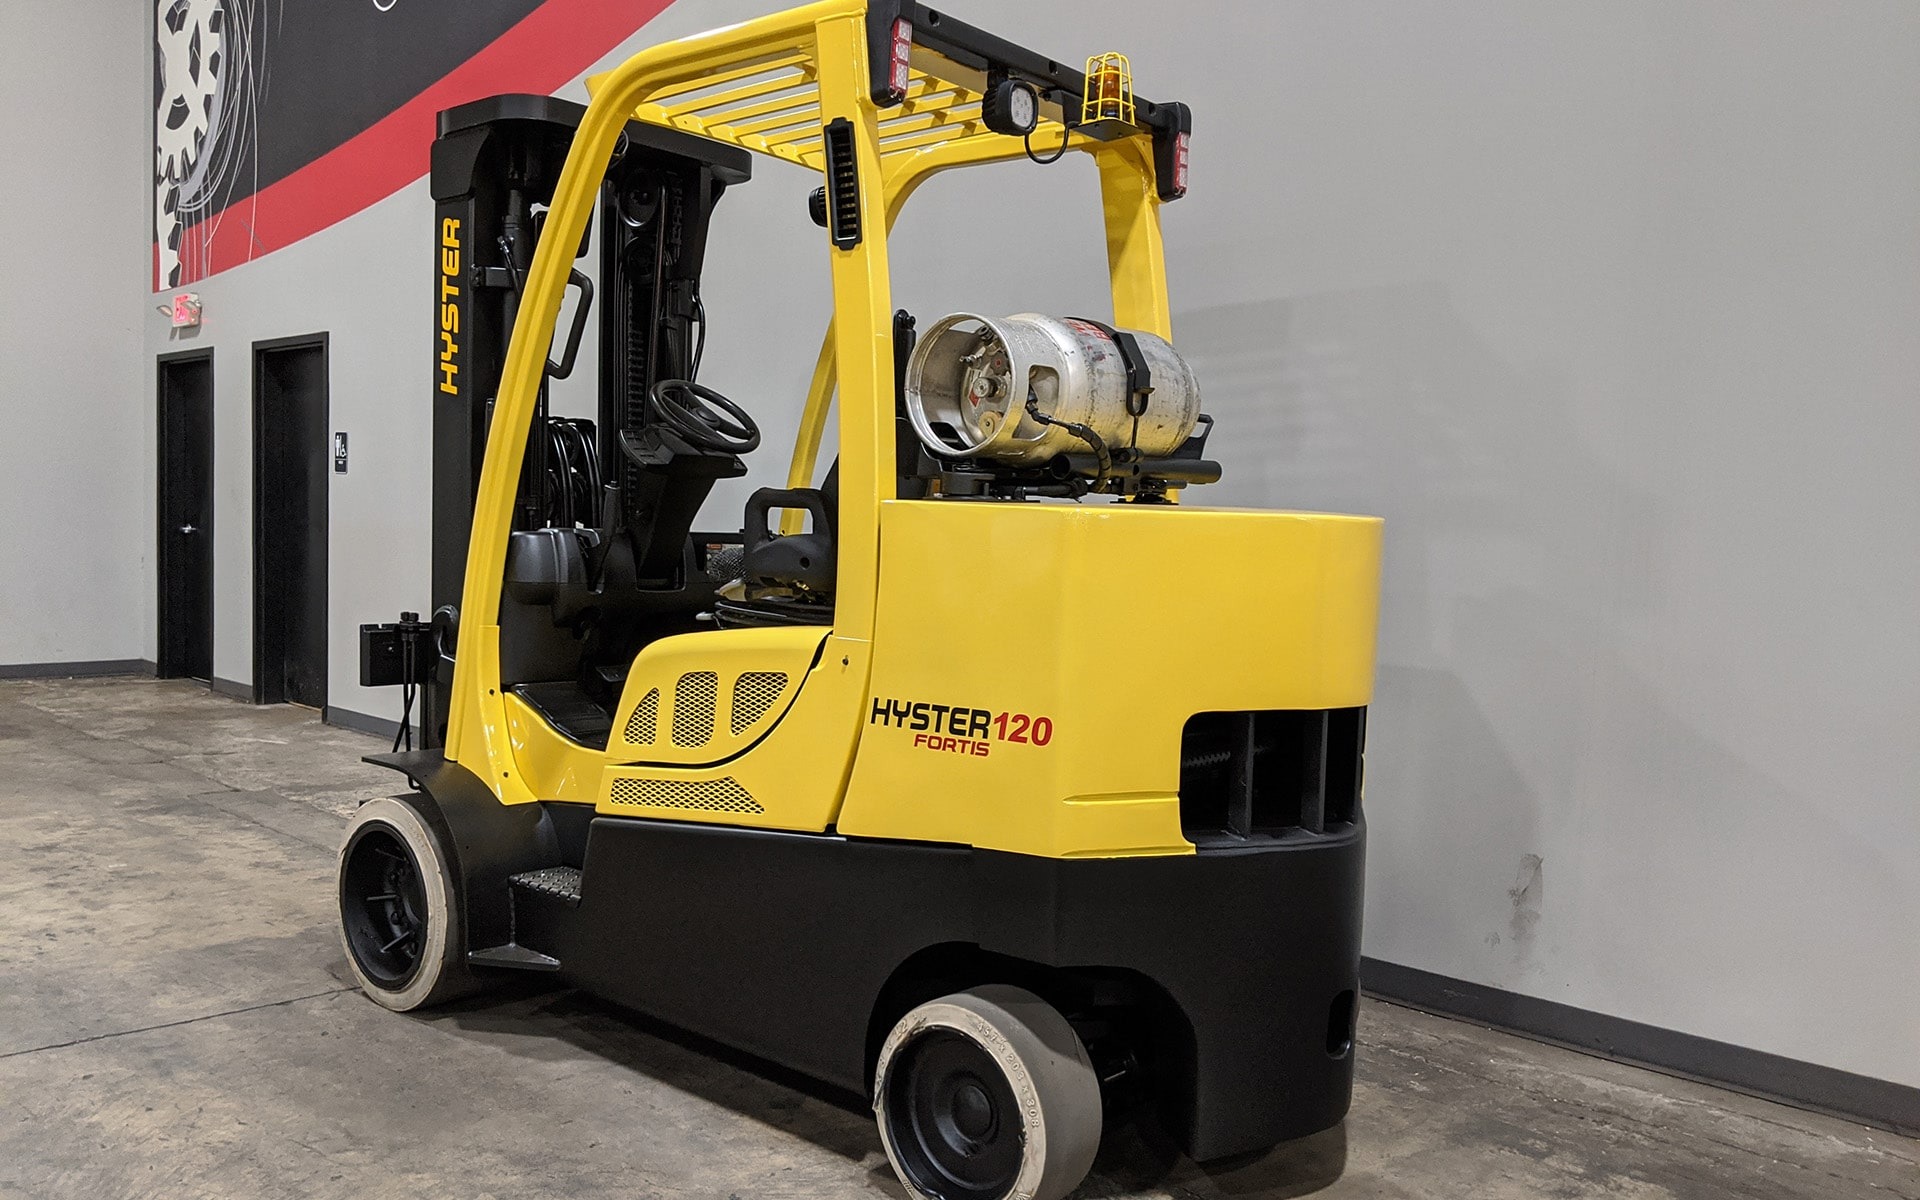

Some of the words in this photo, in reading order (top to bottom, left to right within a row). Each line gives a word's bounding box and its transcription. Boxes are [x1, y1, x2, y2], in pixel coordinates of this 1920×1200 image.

[440, 217, 461, 396] HYSTER
[870, 697, 992, 739] HYSTER
[993, 711, 1053, 747] 120
[913, 734, 990, 757] FORTIS
[1006, 1053, 1025, 1081] 203
[1026, 1098, 1040, 1128] 308
